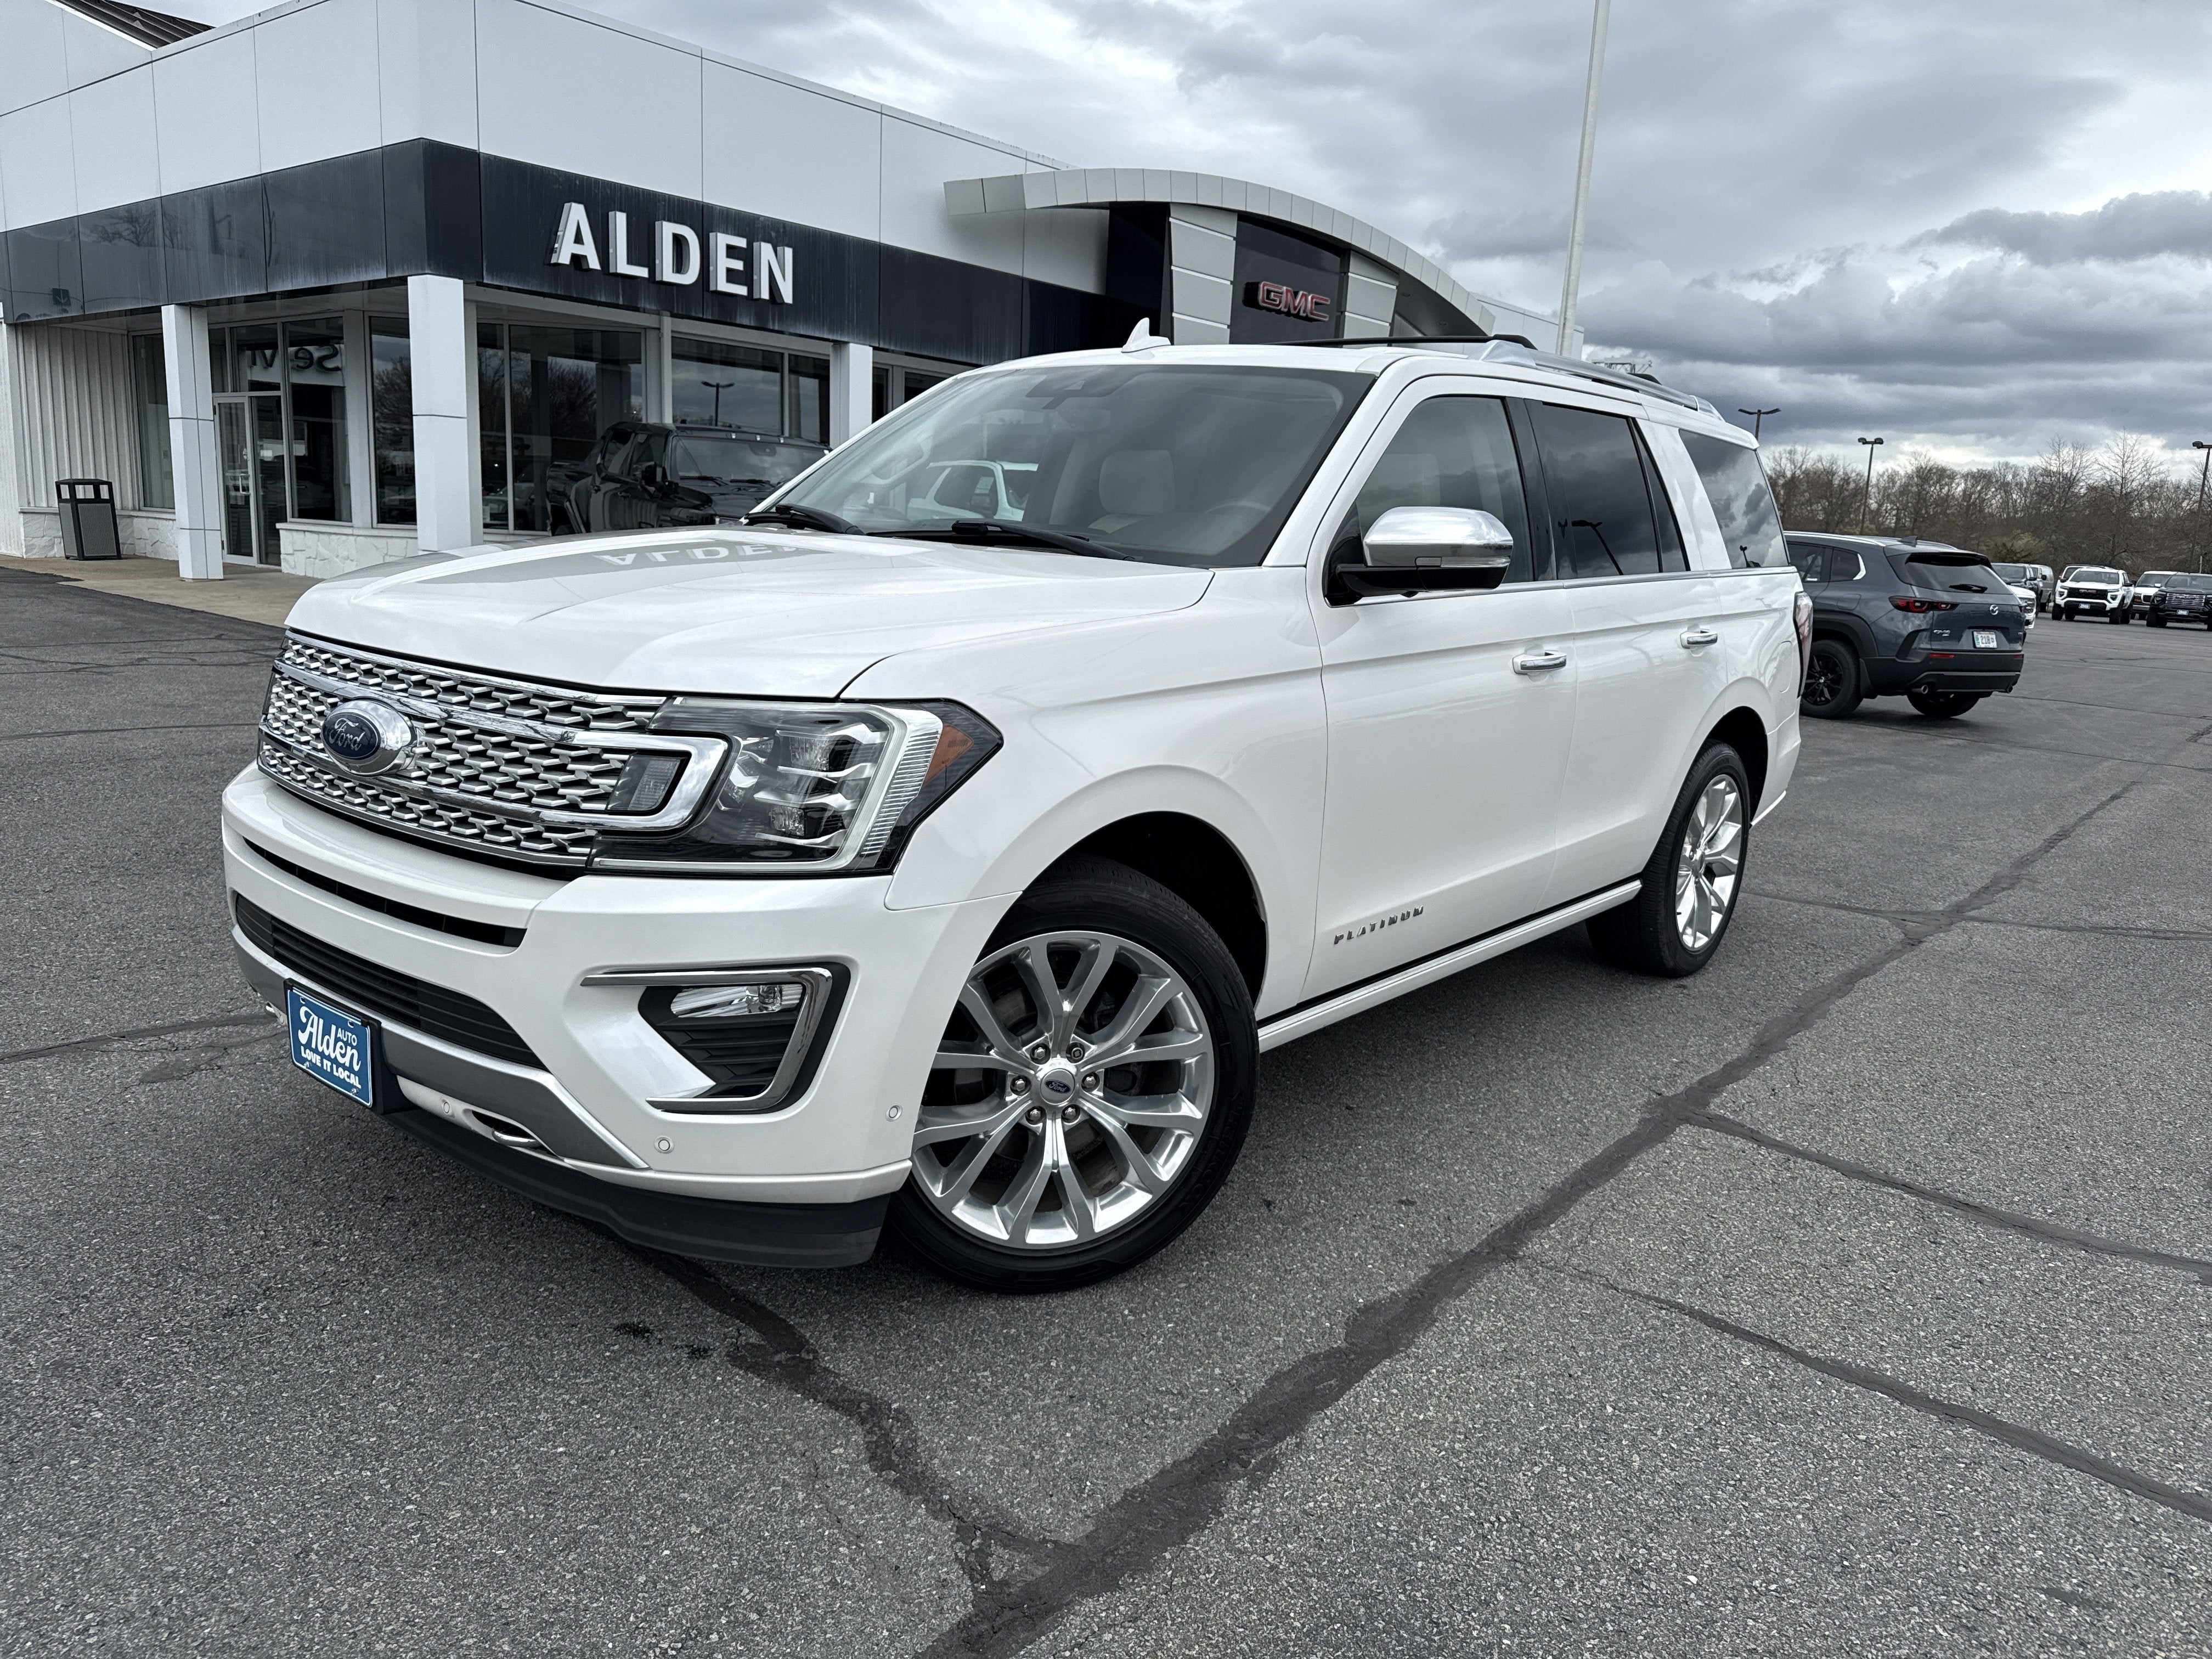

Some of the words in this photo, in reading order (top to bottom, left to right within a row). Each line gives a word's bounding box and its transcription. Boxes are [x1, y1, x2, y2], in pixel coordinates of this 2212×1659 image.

[551, 202, 793, 304] ALDEN
[1259, 281, 1330, 321] GMC
[329, 718, 366, 751] Ford
[1334, 905, 1424, 945] PLATINUM
[298, 1006, 362, 1071] Alden
[337, 1028, 357, 1046] AUTO
[301, 1045, 321, 1067] LOVE
[323, 1058, 332, 1072] IT
[333, 1064, 362, 1089] LOCAL
[1048, 1081, 1068, 1092] Ford
